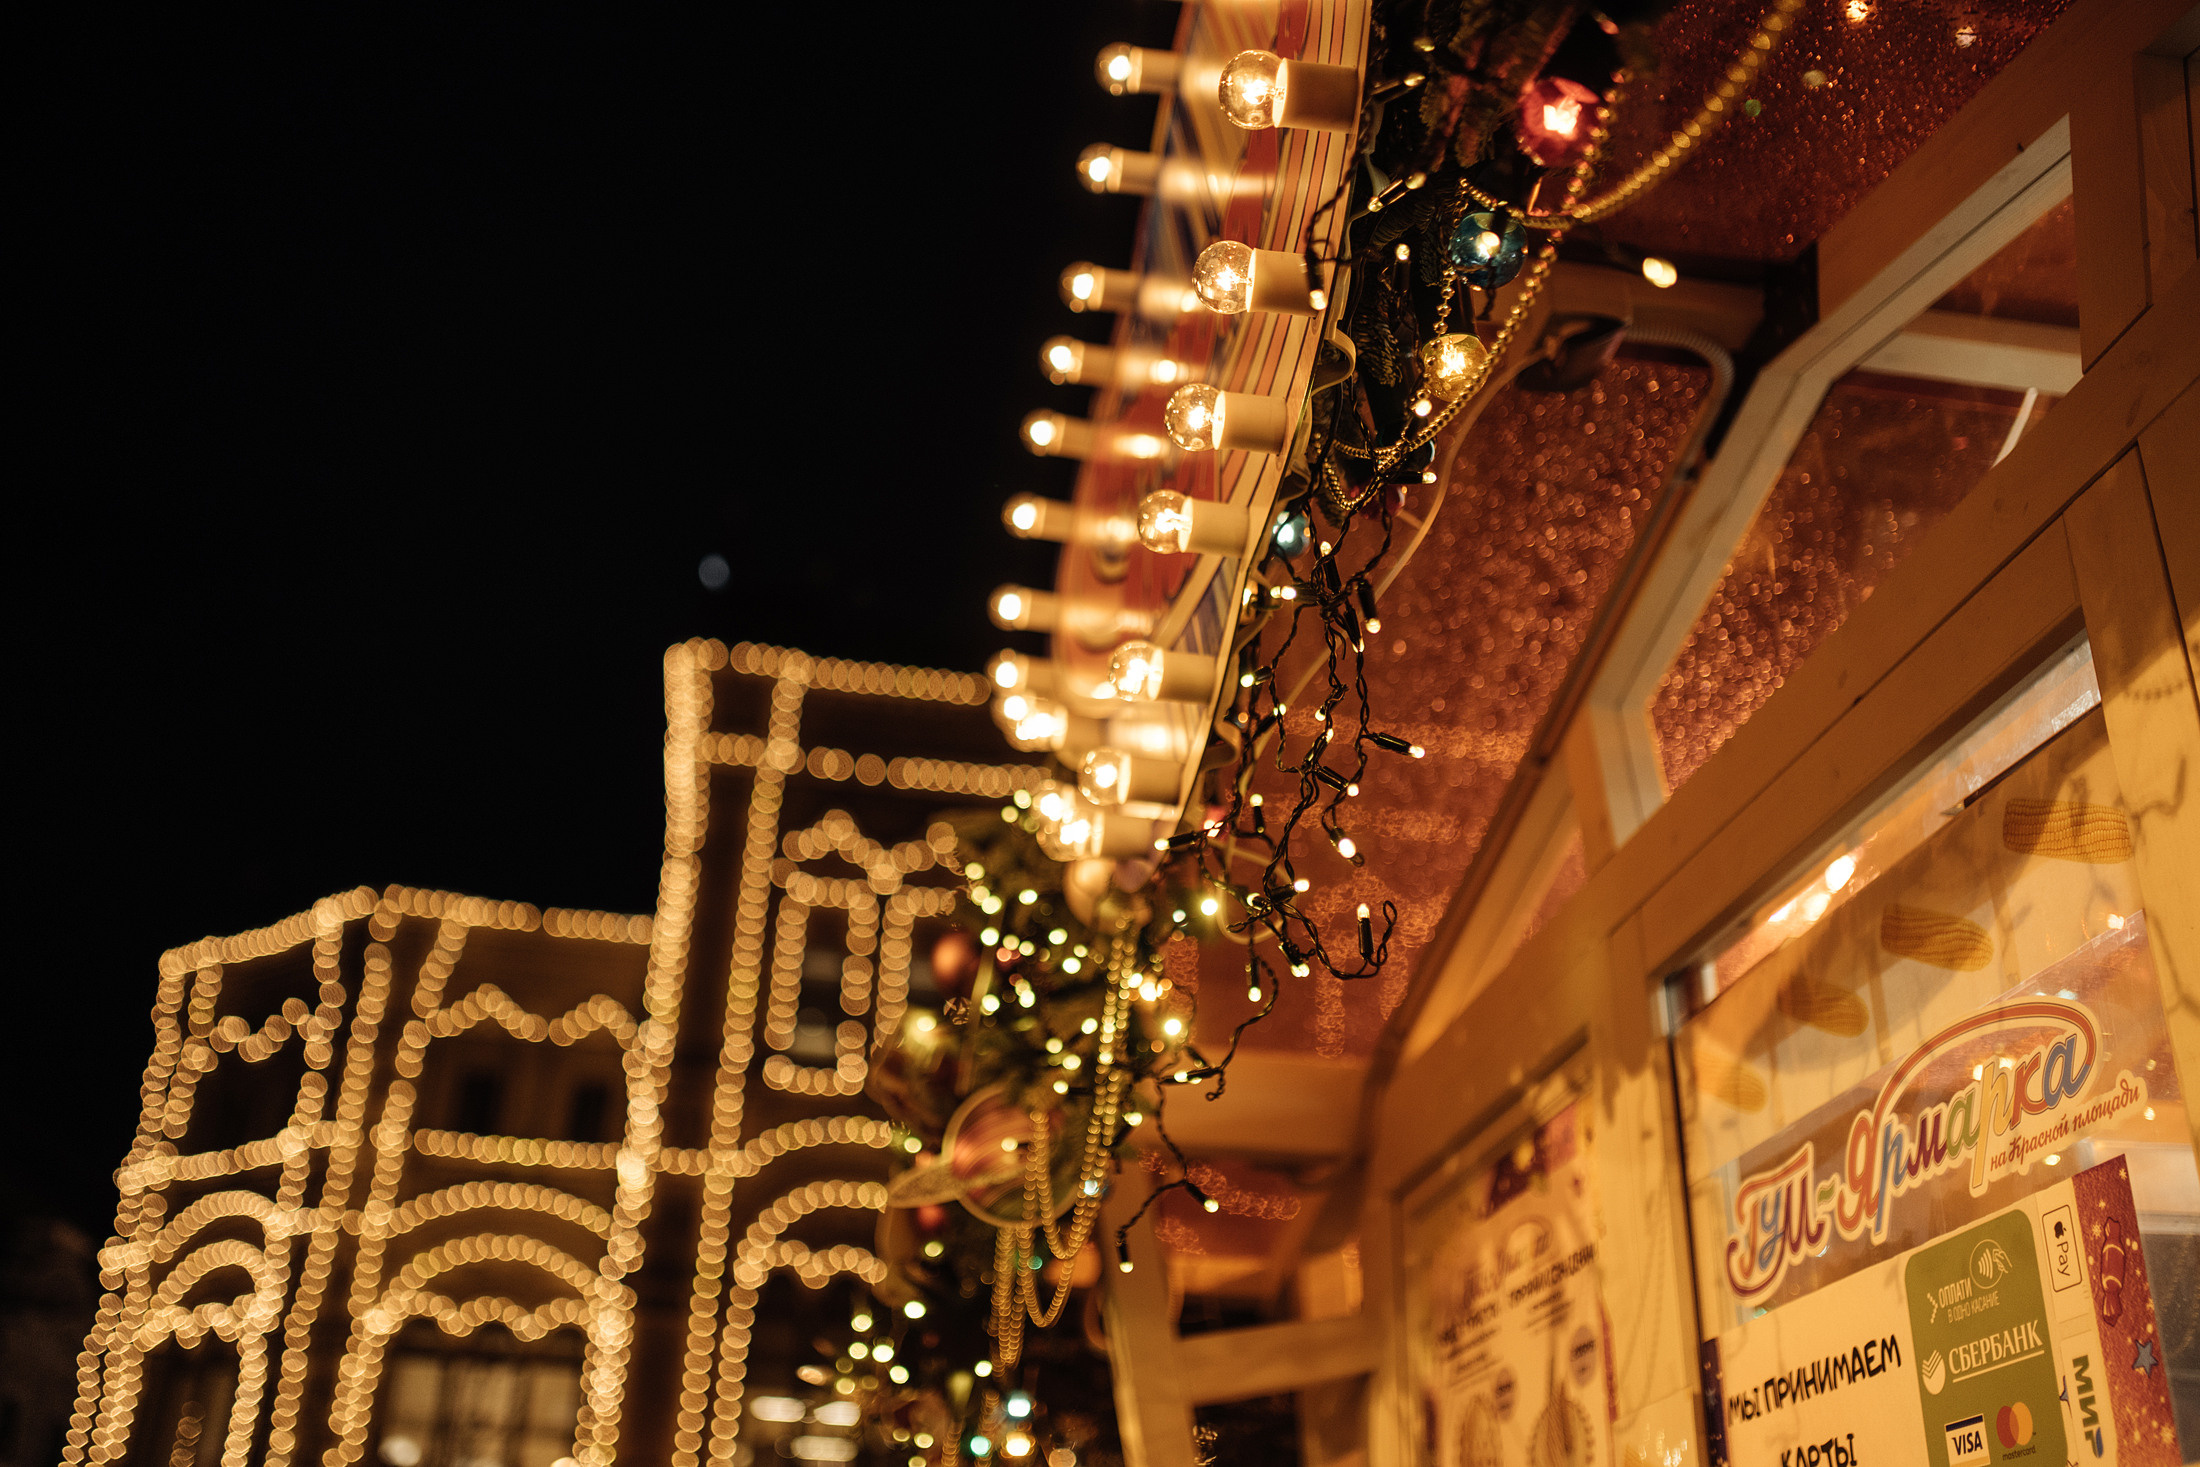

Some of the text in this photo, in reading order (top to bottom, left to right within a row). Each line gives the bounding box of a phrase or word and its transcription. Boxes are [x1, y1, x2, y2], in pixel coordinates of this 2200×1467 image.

[1990, 1078, 2141, 1172] на Красной площади
[2056, 1241, 2071, 1277] Pay
[1938, 1277, 1973, 1309] ОПЛАТИ
[1953, 1302, 1971, 1322] ОДНО
[1971, 1290, 2000, 1314] КАСАНИЕ
[1948, 1319, 2043, 1375] СБЕРБАНК
[1729, 1334, 1902, 1427] МЫ ПРИНИМАЕМ
[2072, 1354, 2104, 1459] МИР
[1952, 1430, 1983, 1456] VISA
[2002, 1444, 2037, 1461] mastercard
